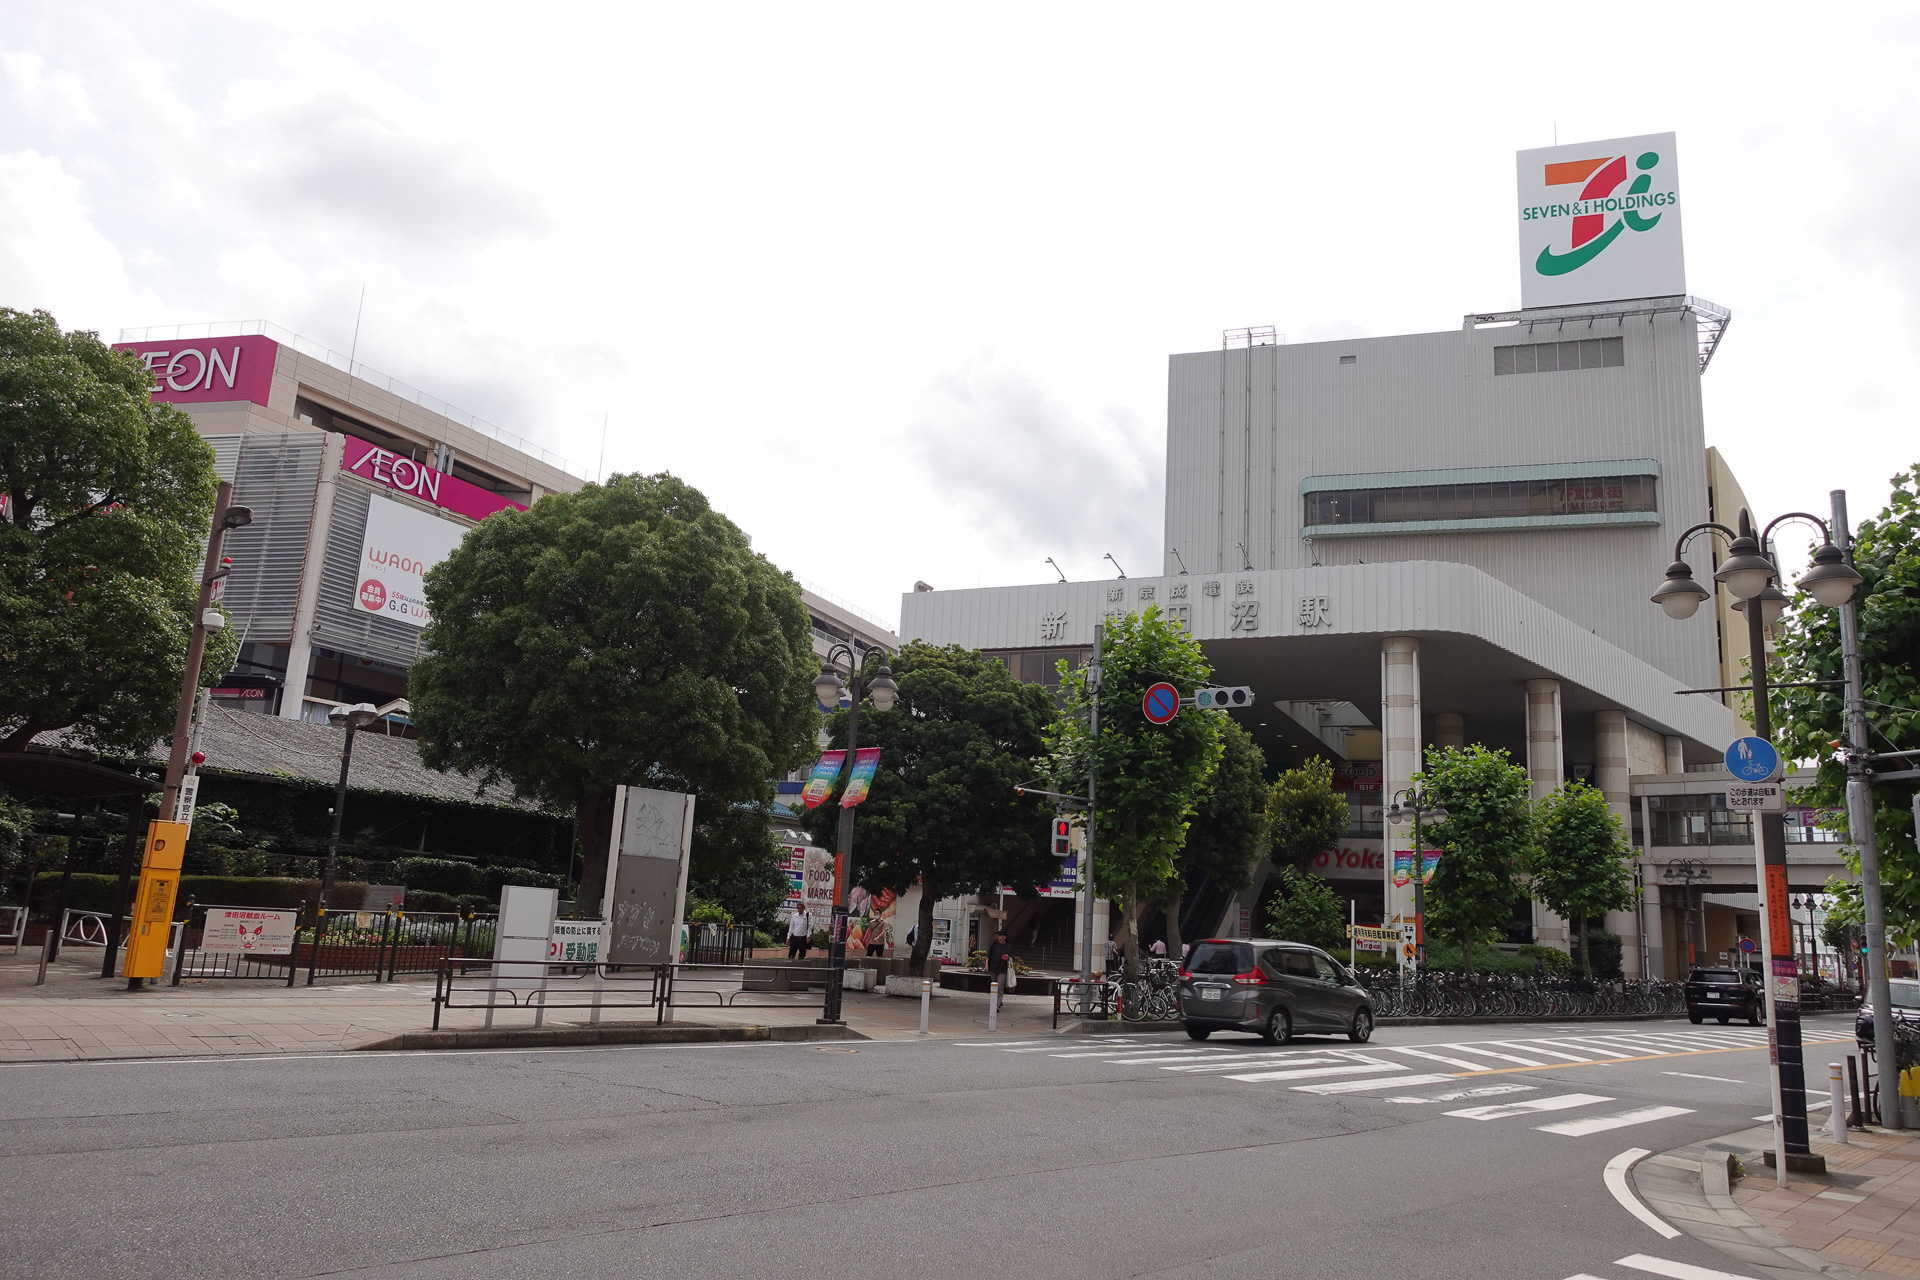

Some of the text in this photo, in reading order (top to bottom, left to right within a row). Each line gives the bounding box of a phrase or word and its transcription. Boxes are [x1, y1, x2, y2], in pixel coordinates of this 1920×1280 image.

[1594, 192, 1675, 212] HOLDINGS
[1108, 579, 1253, 602] 新京成電鉄
[1730, 788, 1776, 796] この歩道は自転車
[1731, 797, 1764, 806] もとおれます
[808, 869, 831, 882] FOOD
[224, 911, 281, 920] 津田沼献血ルーム
